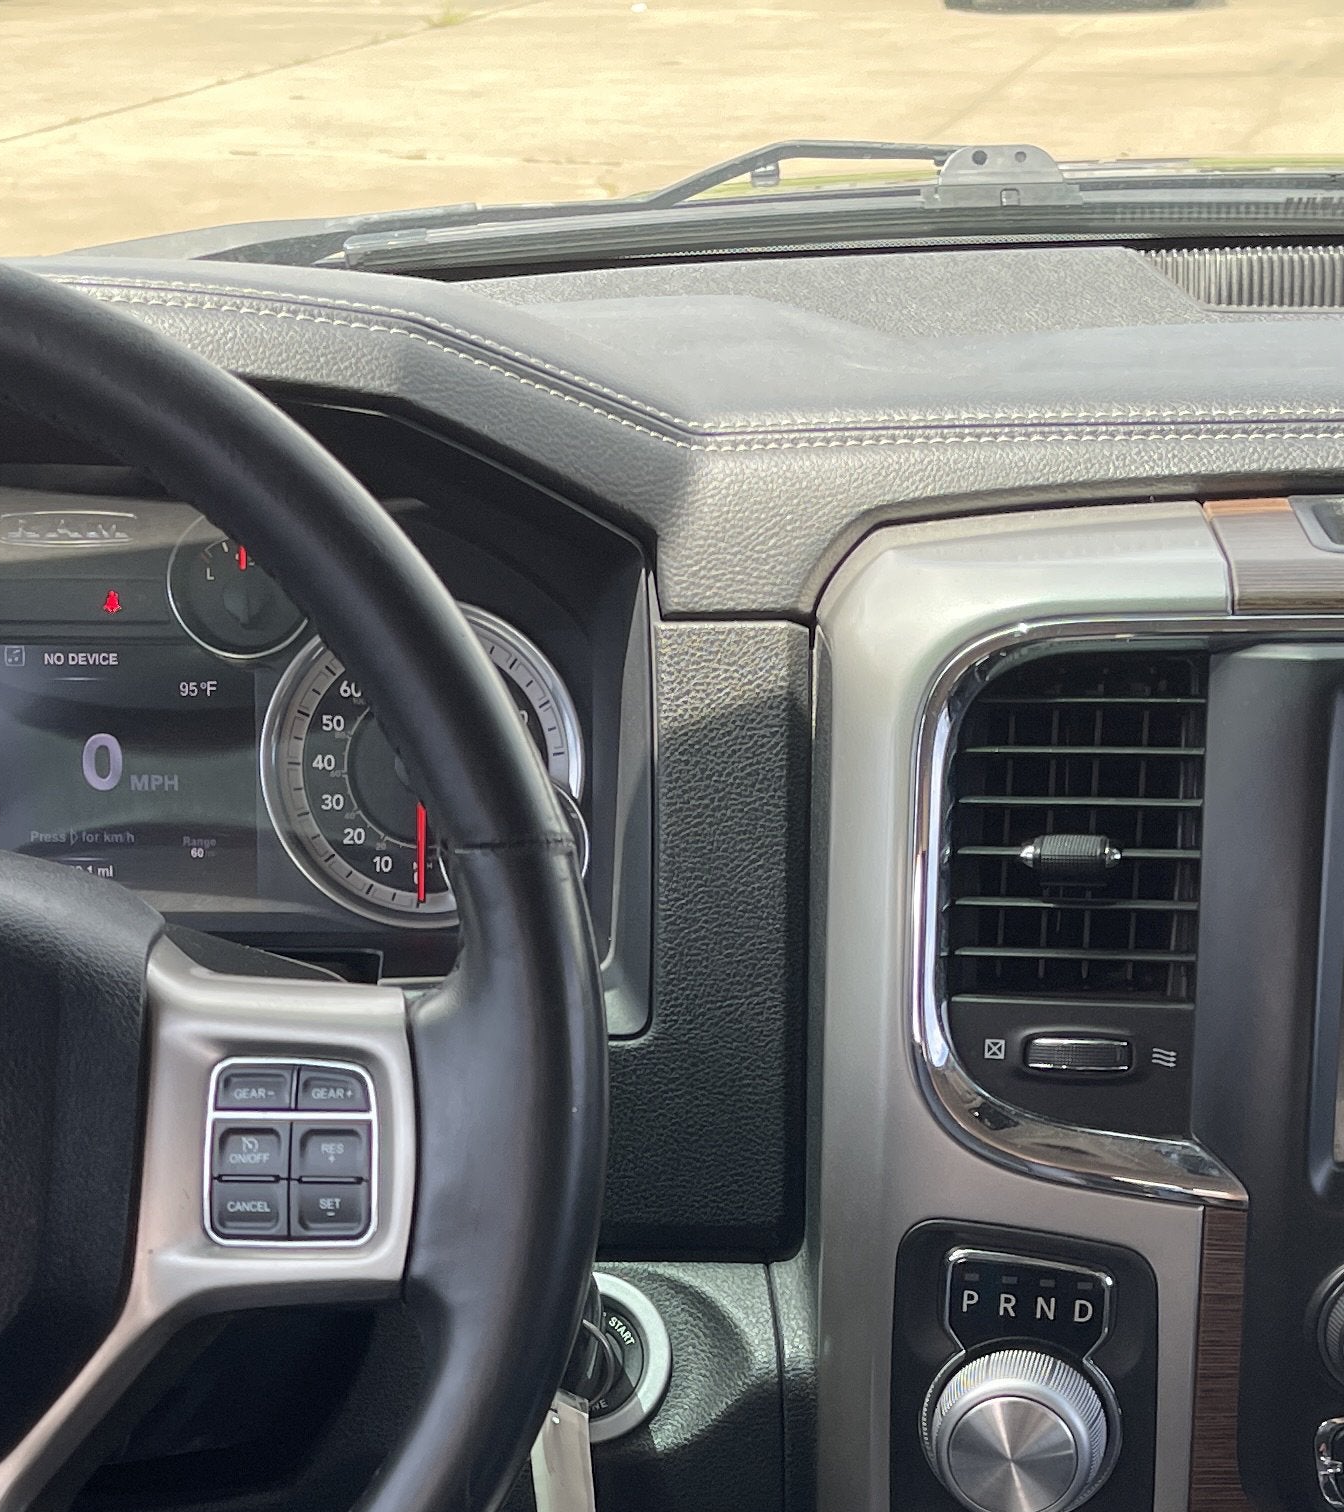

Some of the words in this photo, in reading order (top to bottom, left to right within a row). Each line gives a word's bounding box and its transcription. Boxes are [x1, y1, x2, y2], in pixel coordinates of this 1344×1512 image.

[207, 568, 214, 580] L
[44, 653, 64, 665] NO
[68, 653, 119, 665] DEVICE
[322, 715, 344, 731] 50
[82, 733, 122, 791] 0
[130, 775, 178, 791] MPH
[312, 754, 335, 770] 40
[321, 794, 344, 811] 30
[30, 831, 66, 842] Press
[82, 830, 99, 842] for
[183, 836, 216, 848] Range
[343, 828, 365, 845] 20
[191, 847, 204, 858] 60
[373, 856, 392, 873] 10
[321, 1143, 344, 1154] RES
[227, 1201, 270, 1213] CANCEL
[319, 1198, 341, 1209] SET
[962, 1290, 979, 1312] P
[999, 1294, 1016, 1317] R
[1036, 1297, 1055, 1320] N
[1074, 1300, 1093, 1322] D
[608, 1316, 635, 1345] START
